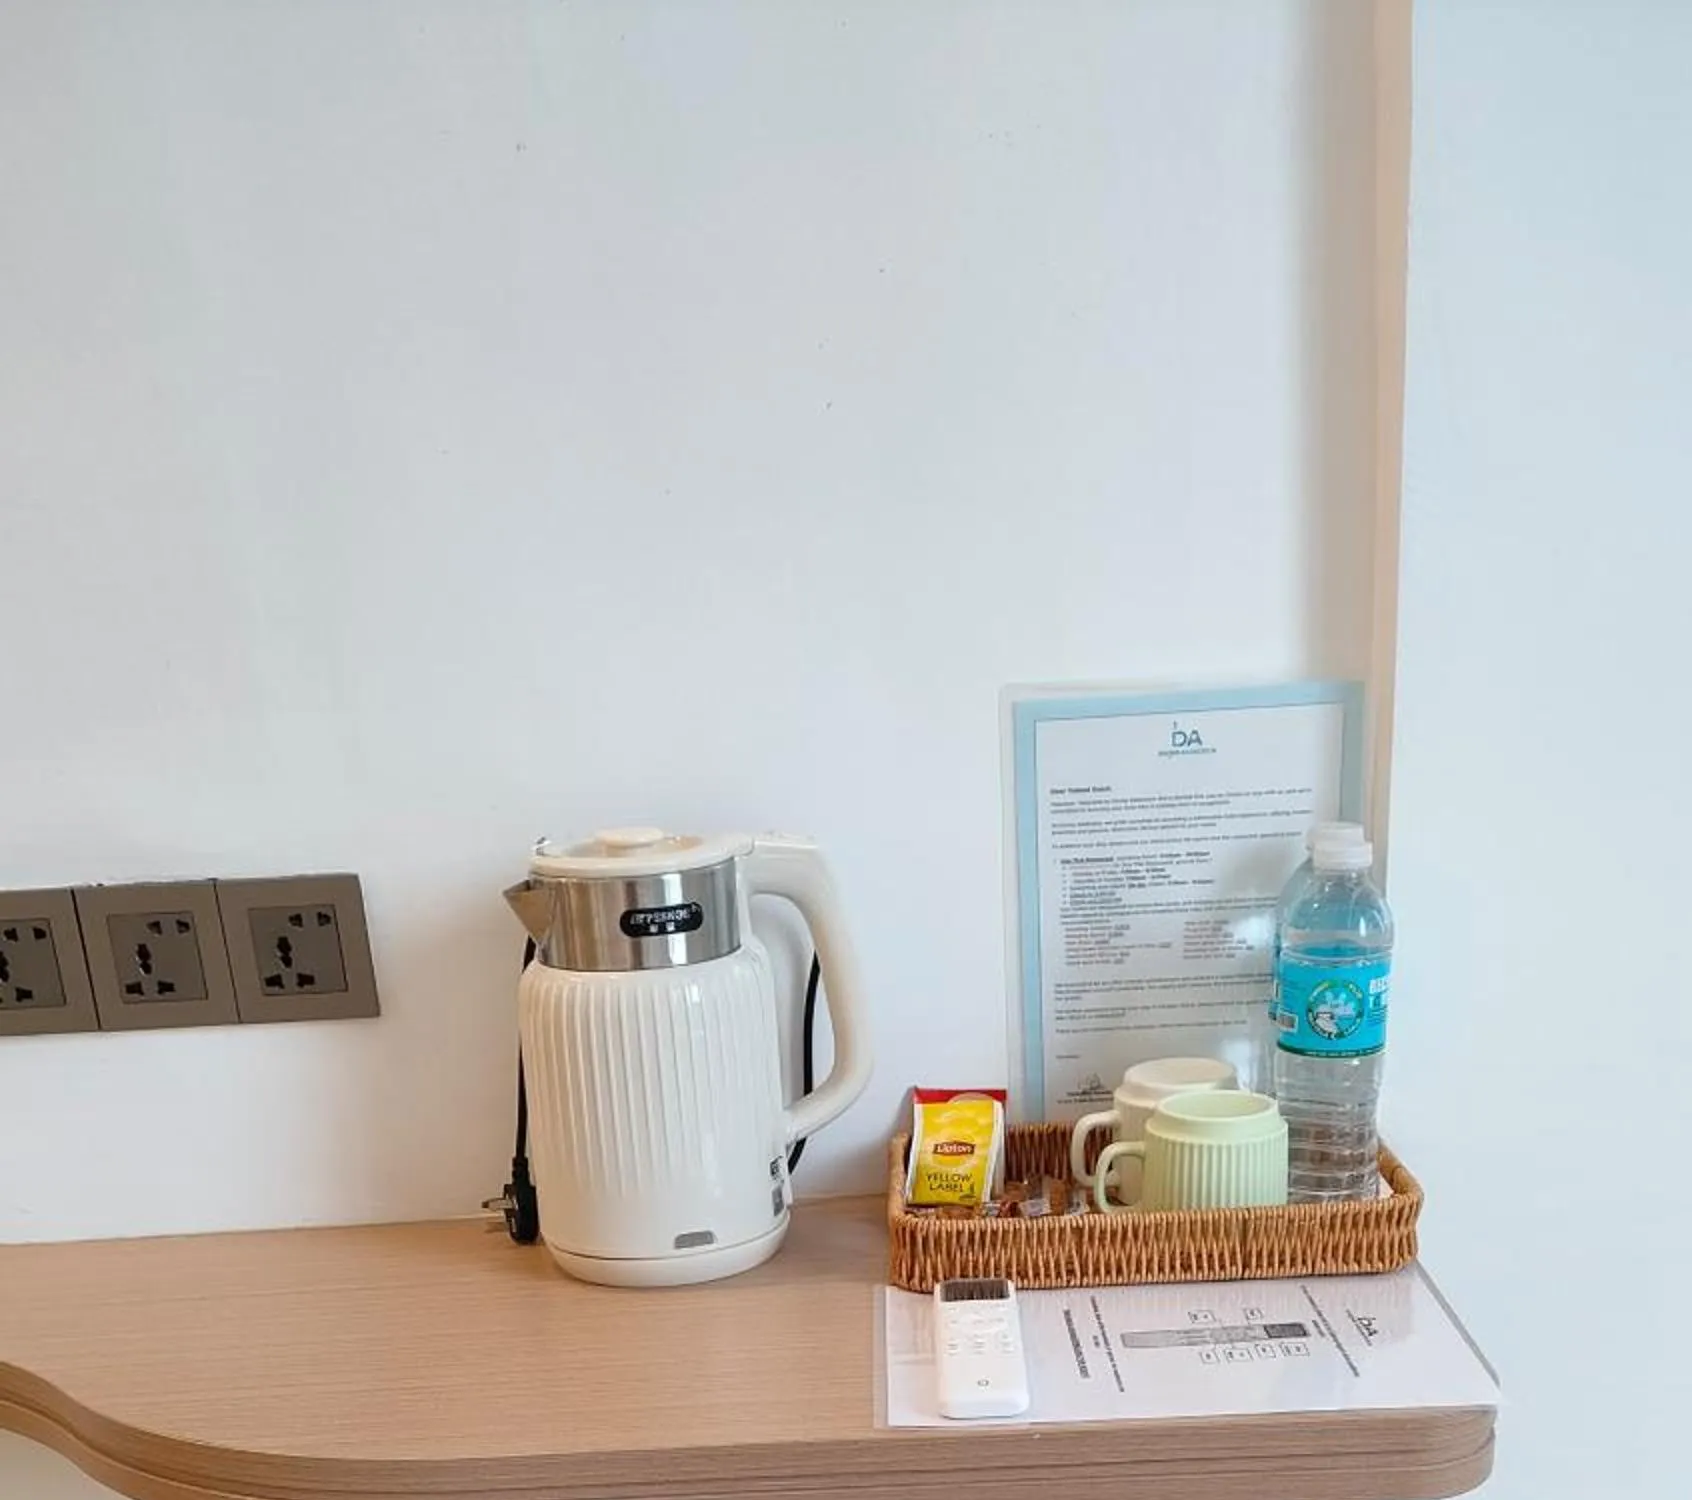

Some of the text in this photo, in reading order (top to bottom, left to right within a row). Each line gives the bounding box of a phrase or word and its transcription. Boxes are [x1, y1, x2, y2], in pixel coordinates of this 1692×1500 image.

[937, 1144, 972, 1154] Lipton
[926, 1173, 972, 1183] YELLOW
[929, 1183, 964, 1193] LABEL
